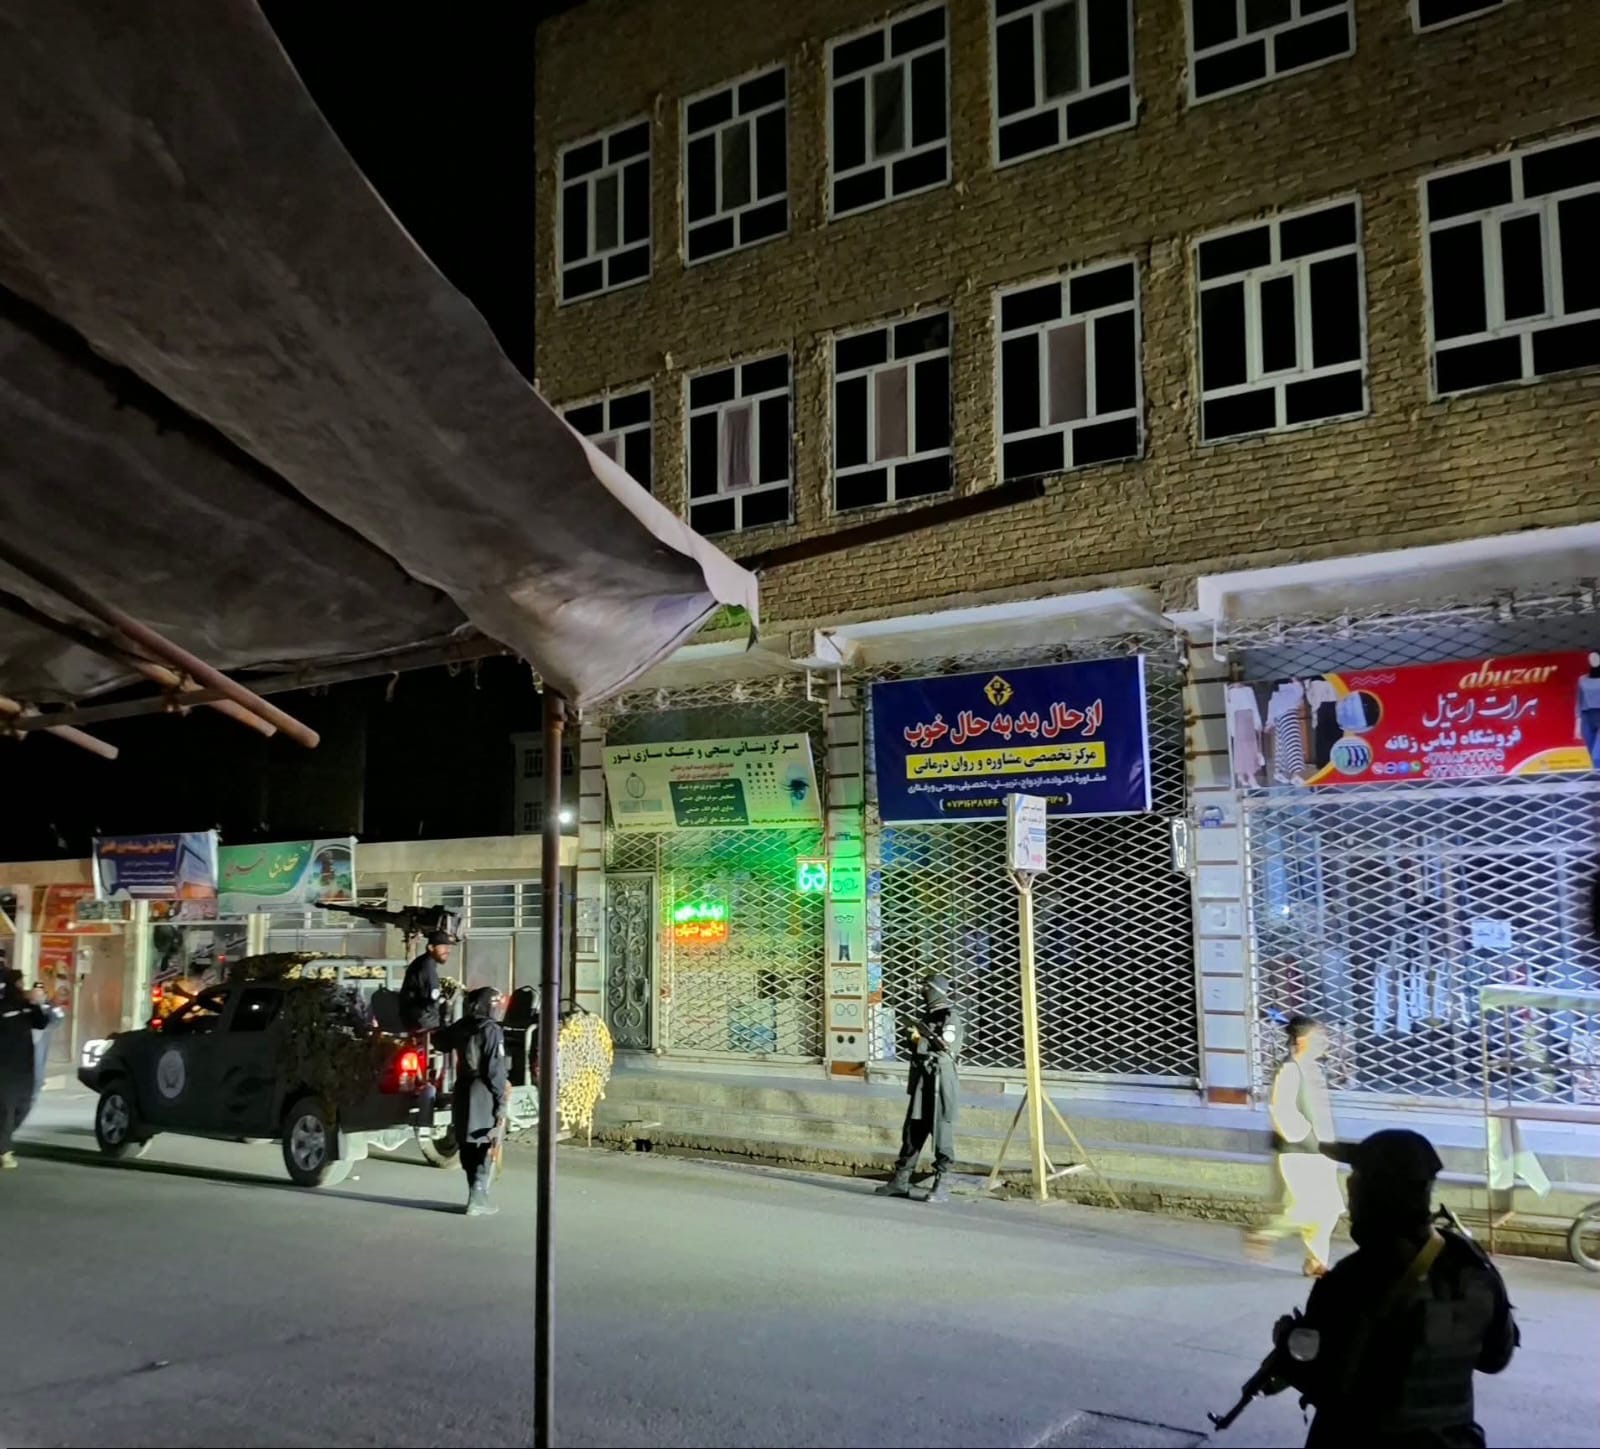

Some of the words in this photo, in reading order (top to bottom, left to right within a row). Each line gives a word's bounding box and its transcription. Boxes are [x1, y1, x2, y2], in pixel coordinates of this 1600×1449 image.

[1459, 658, 1558, 691] abuzar
[1041, 700, 1084, 737] حال
[1081, 698, 1103, 736] از
[1422, 692, 1475, 728] استایل
[903, 713, 948, 749] خوب
[950, 710, 989, 745] حال
[992, 712, 1013, 740] به
[1015, 710, 1040, 739] بد
[1384, 735, 1418, 753] زنانه
[1420, 730, 1456, 752] لباس
[1460, 725, 1521, 747] فروشگاه
[633, 748, 663, 763] سازی
[664, 745, 694, 759] عینک
[697, 749, 702, 759] و
[704, 744, 731, 759] سنجی
[770, 739, 800, 755] مرکز
[1073, 747, 1097, 765] مرکز
[612, 749, 632, 765] نور
[913, 757, 949, 775] درمانی
[951, 757, 974, 773] روان
[977, 760, 984, 771] و
[987, 752, 1022, 770] مشاوره
[1024, 750, 1072, 769] تخصصی
